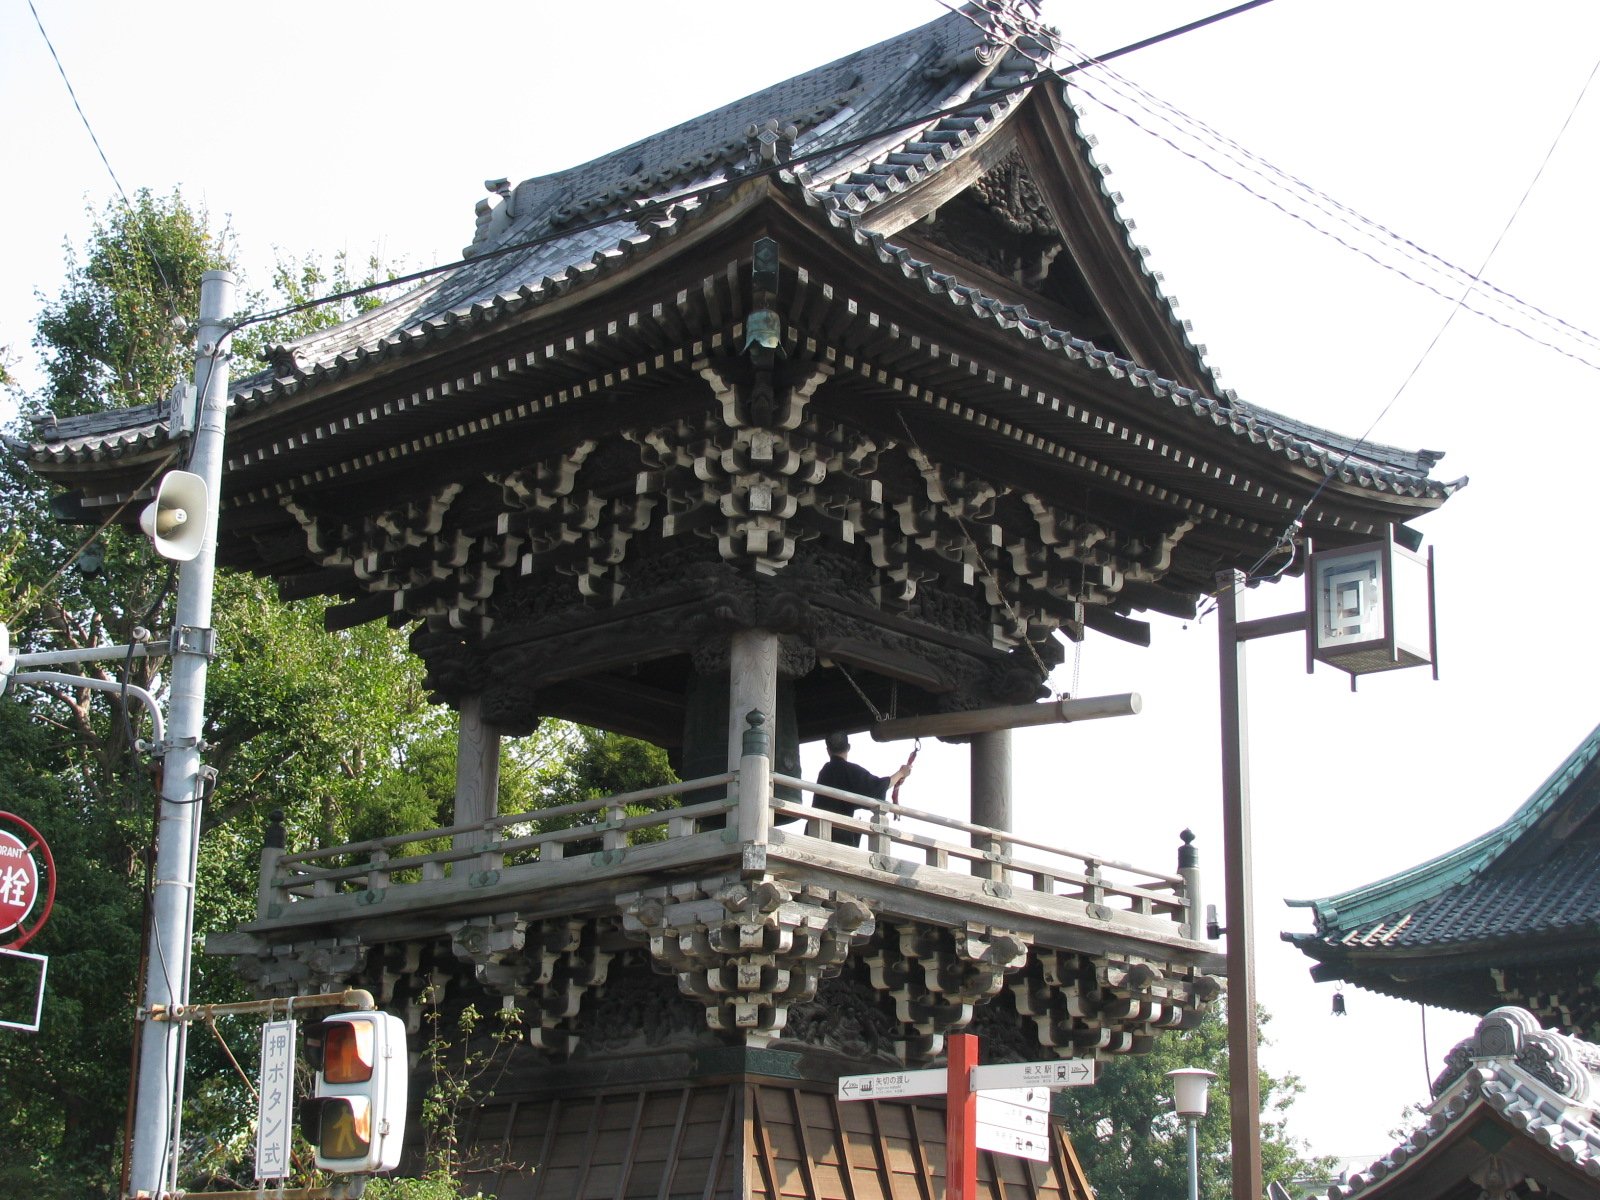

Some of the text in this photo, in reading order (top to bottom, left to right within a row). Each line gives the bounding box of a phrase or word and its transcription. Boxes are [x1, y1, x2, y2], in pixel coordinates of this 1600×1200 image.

[1024, 1064, 1052, 1075] 柴又駅
[875, 1075, 910, 1086] 矢切の渡し
[263, 1034, 287, 1164] 押ボタン式
